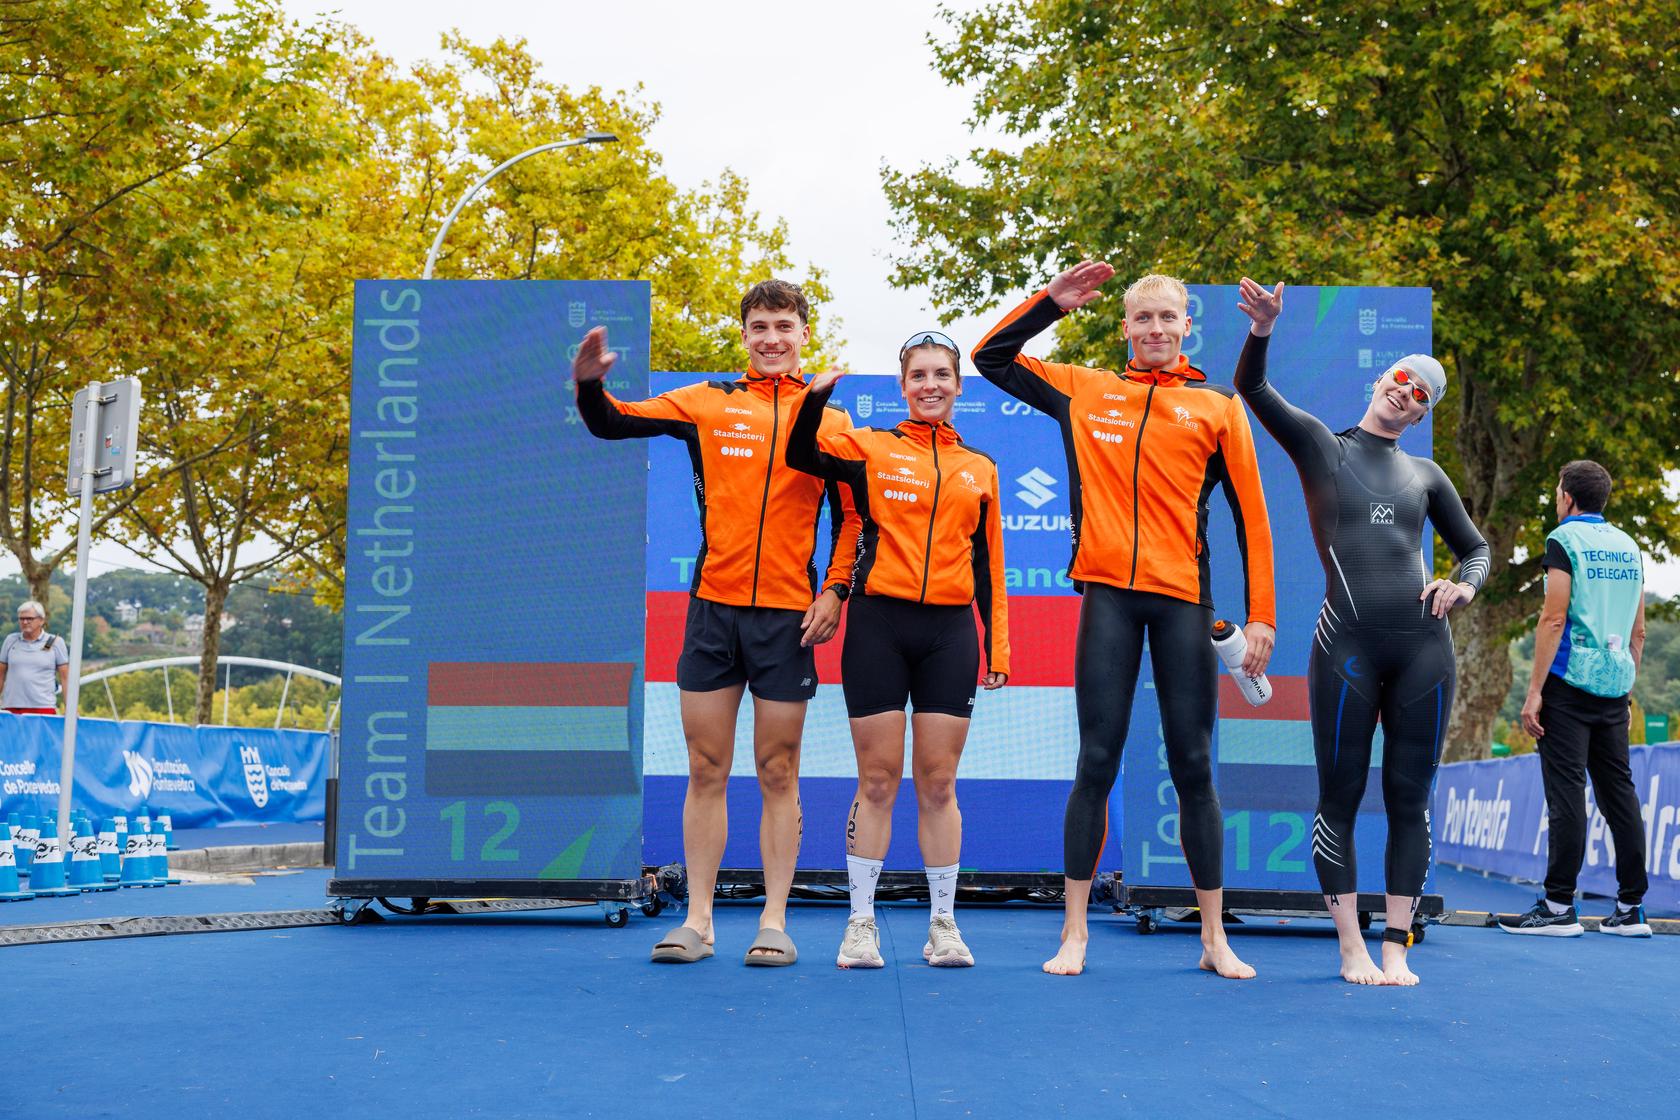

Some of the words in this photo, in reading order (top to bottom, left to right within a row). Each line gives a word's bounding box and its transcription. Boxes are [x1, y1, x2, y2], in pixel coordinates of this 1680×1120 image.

[1088, 413, 1135, 429] Staatsloterij
[713, 429, 765, 443] Staatsloterij
[355, 288, 422, 646] Netherlands
[877, 471, 930, 489] Staatsloterij
[1001, 515, 1072, 531] UZUK
[1581, 550, 1639, 563] TECHNICA
[1587, 567, 1639, 581] DELEGATE
[17, 779, 61, 795] Poevedra
[347, 711, 409, 870] Team
[439, 800, 521, 862] 12
[1223, 810, 1306, 873] 12
